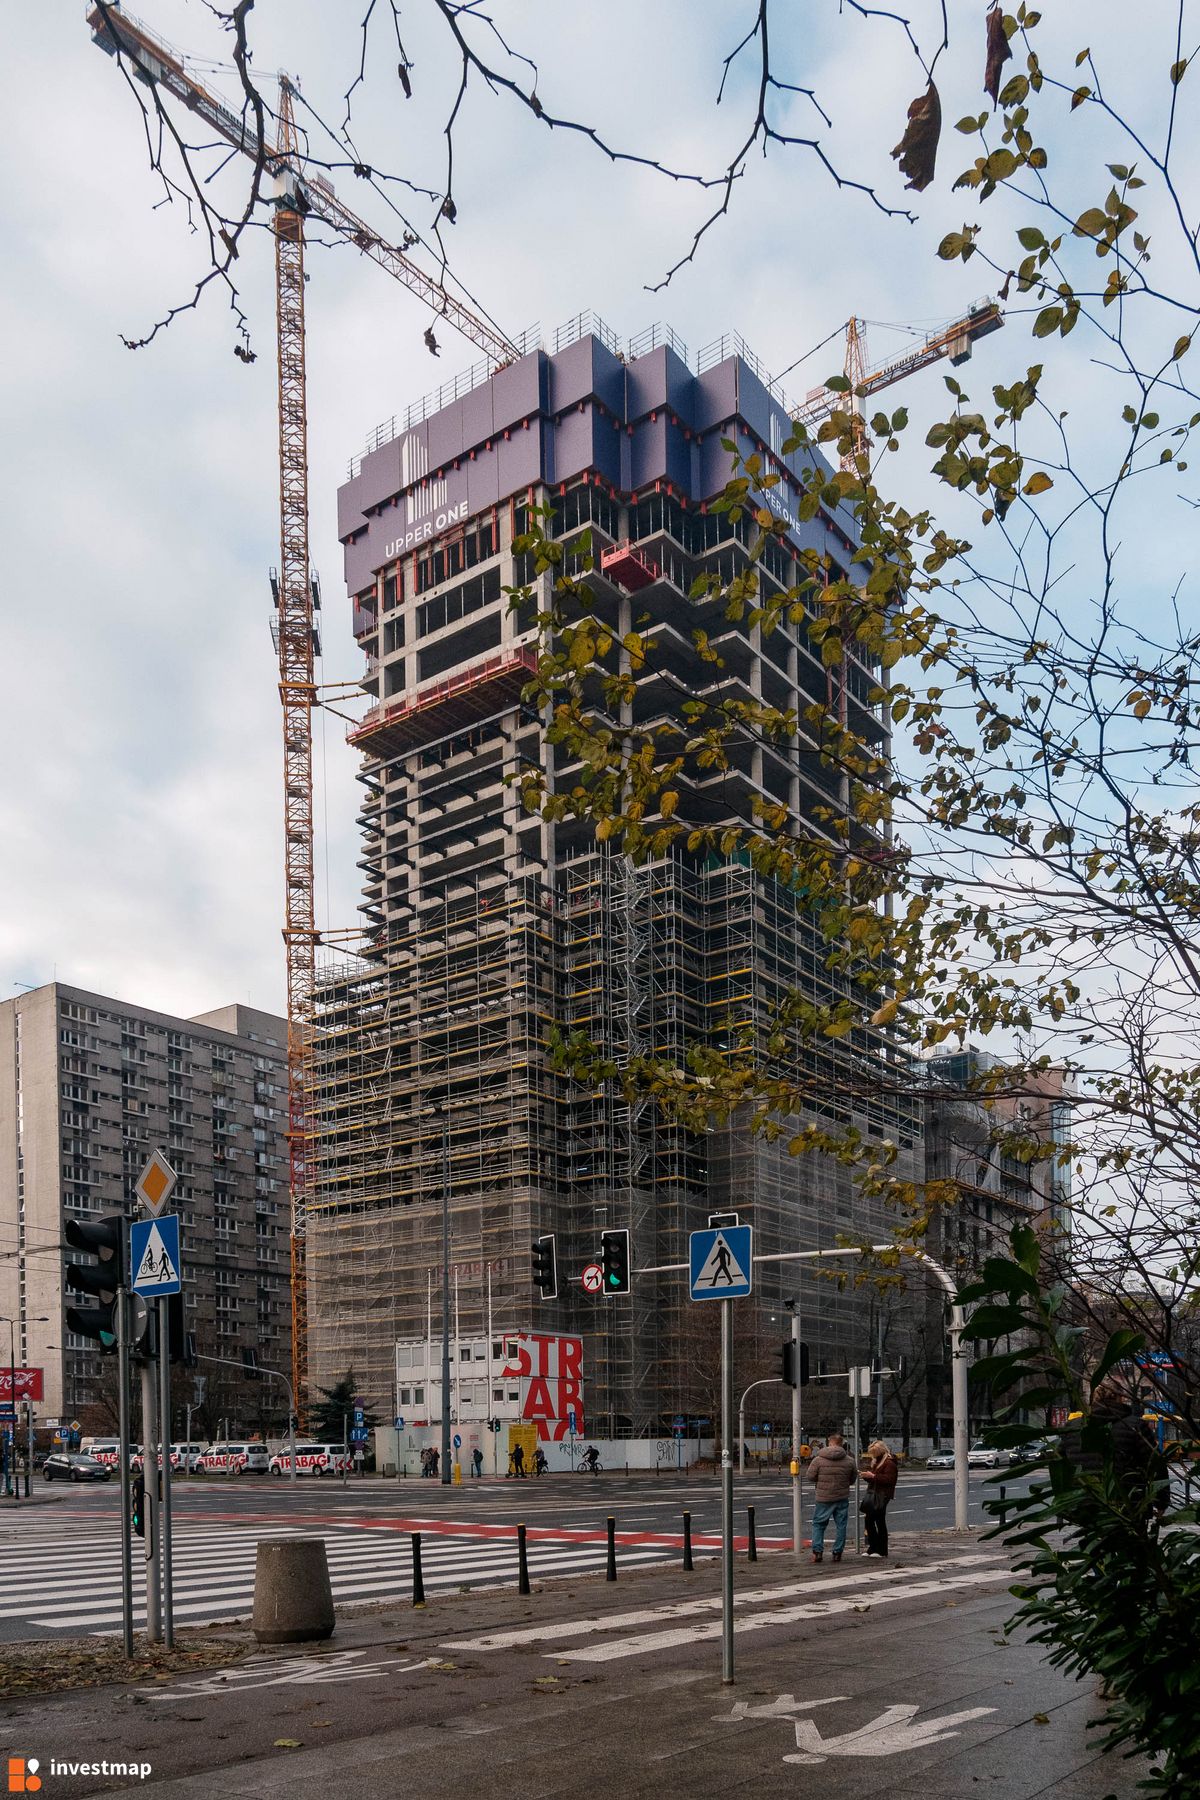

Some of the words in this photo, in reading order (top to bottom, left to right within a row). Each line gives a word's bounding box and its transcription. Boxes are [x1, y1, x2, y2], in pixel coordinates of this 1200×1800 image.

[385, 522, 432, 558] UPPER
[436, 500, 468, 530] ONE
[783, 508, 801, 536] ONE
[501, 1333, 583, 1379] STR
